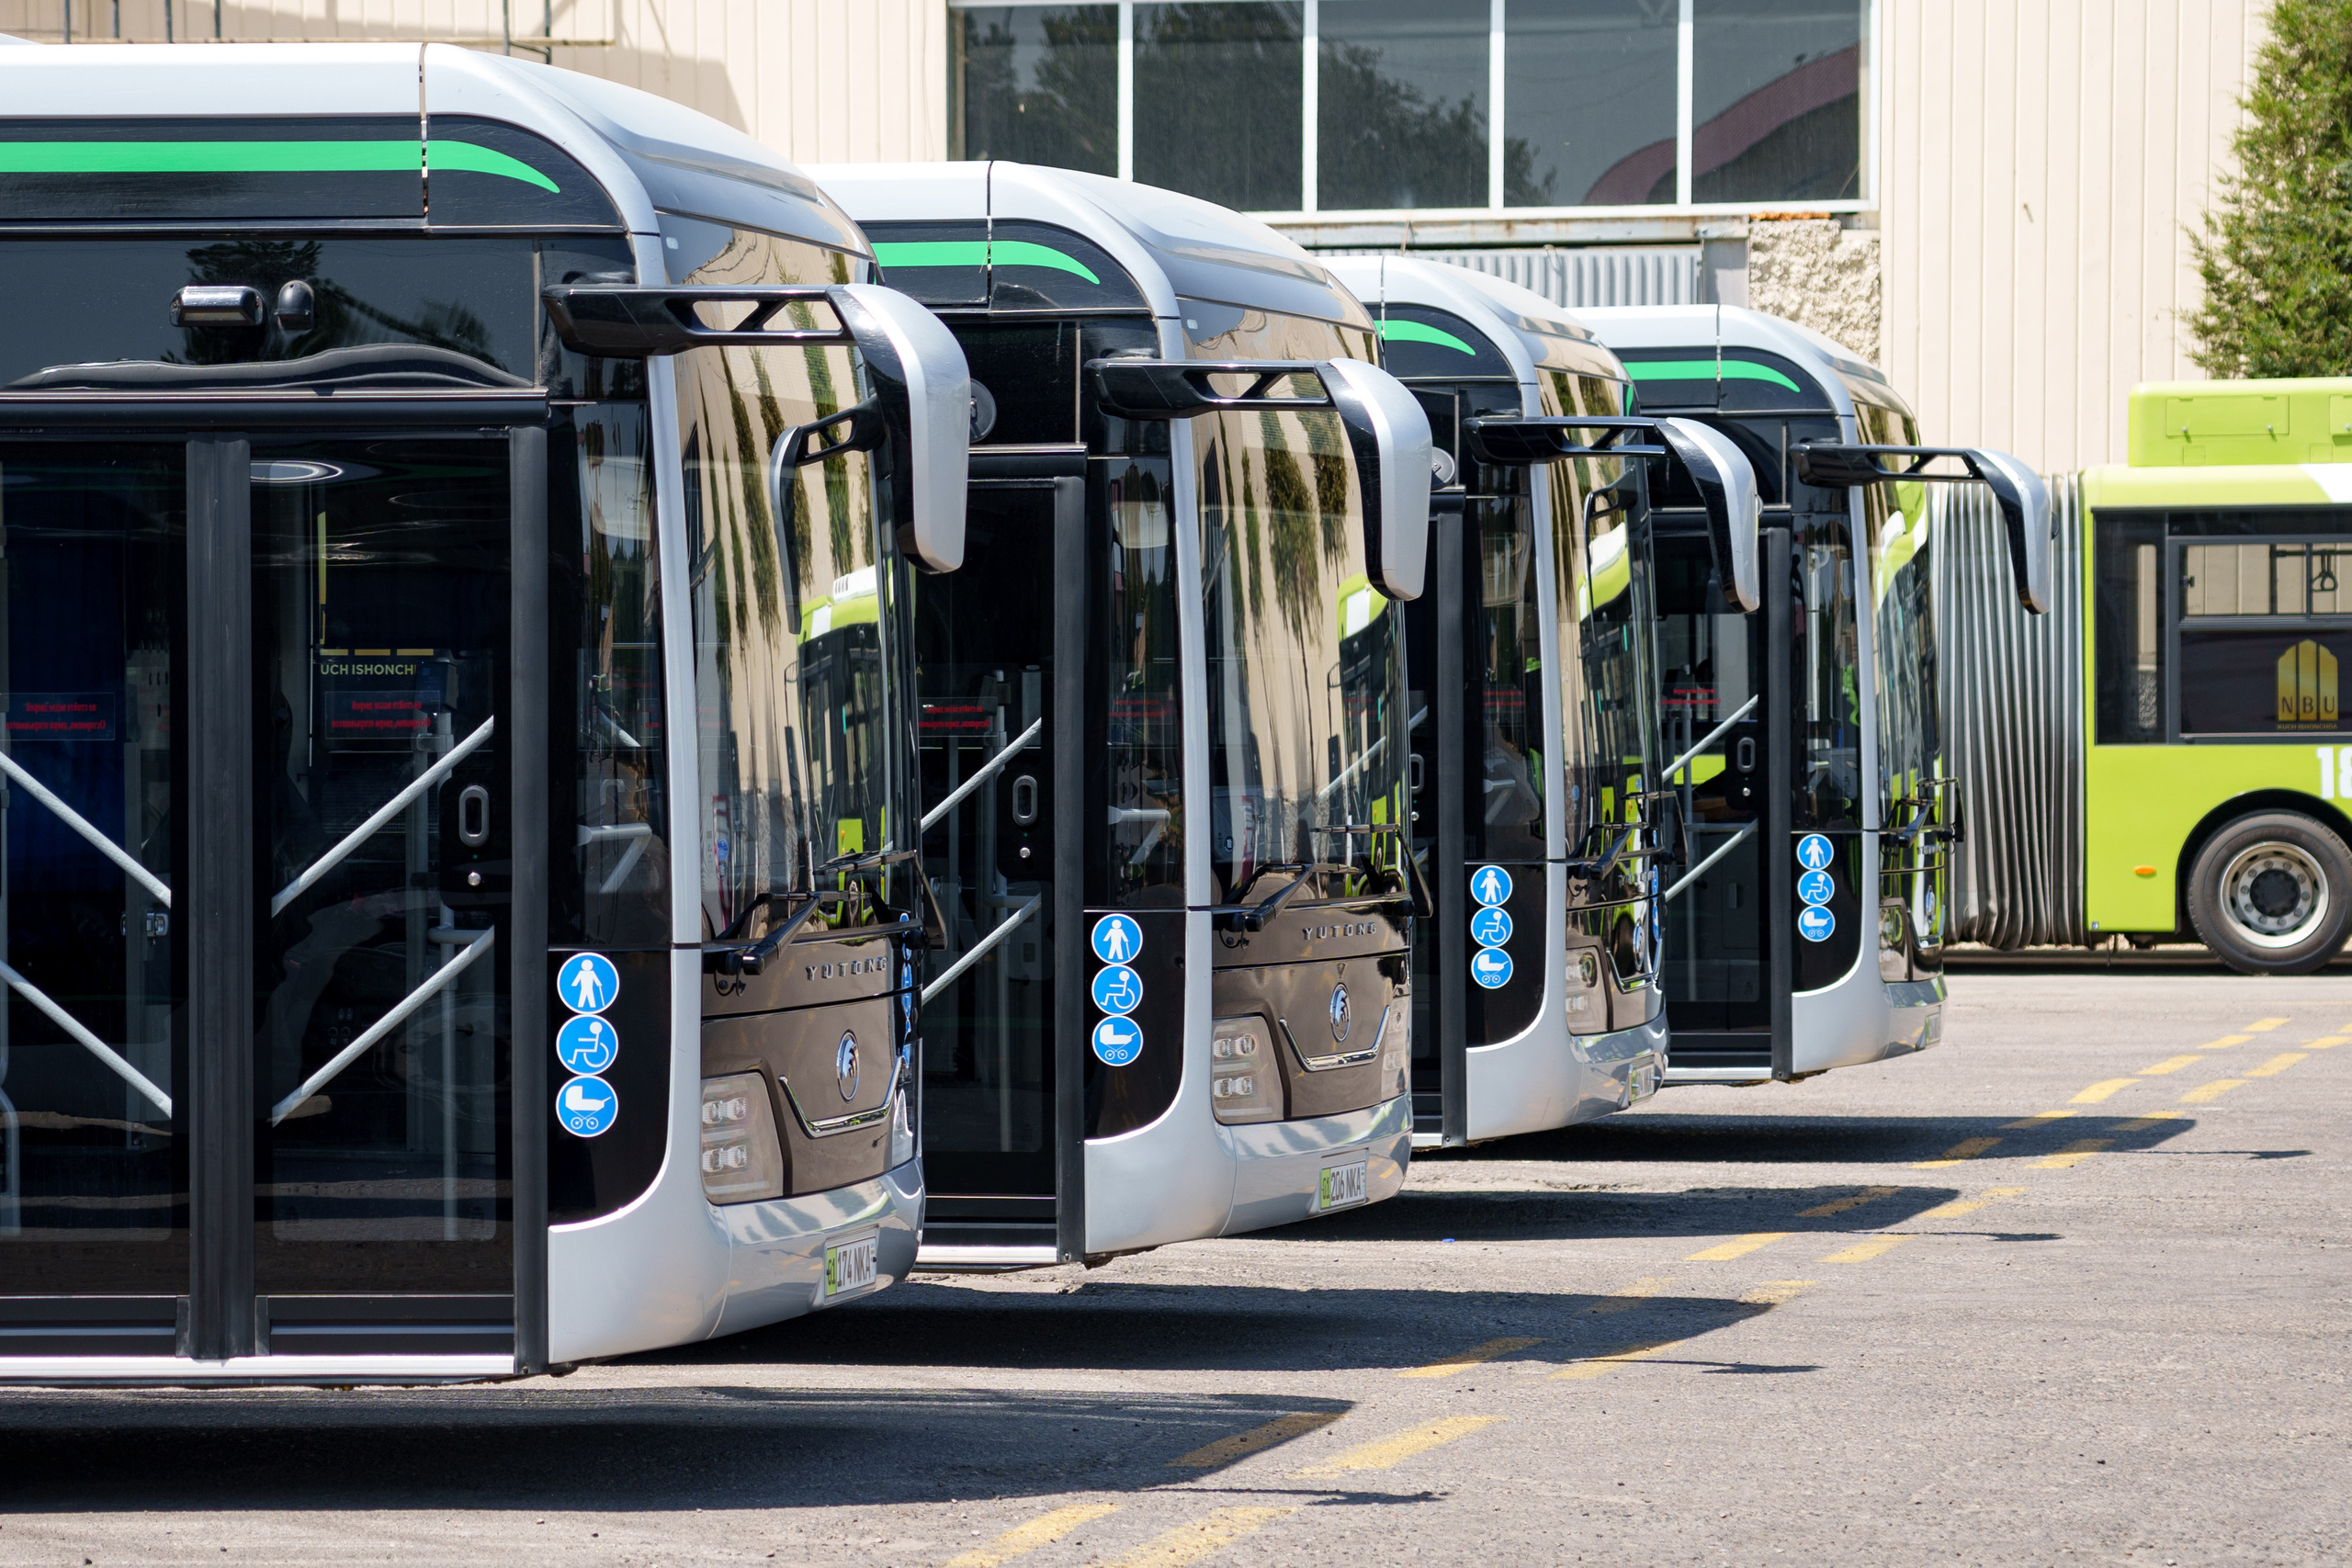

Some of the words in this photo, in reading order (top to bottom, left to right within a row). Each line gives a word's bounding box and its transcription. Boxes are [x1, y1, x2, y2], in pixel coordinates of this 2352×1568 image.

[2281, 695, 2335, 715] NBU
[1302, 921, 1377, 941] YUTONG
[805, 956, 888, 981] YUTONG
[1330, 1169, 1345, 1201] 206
[1346, 1167, 1362, 1199] NKA
[837, 1249, 853, 1288] 174
[854, 1245, 871, 1282] NKA
